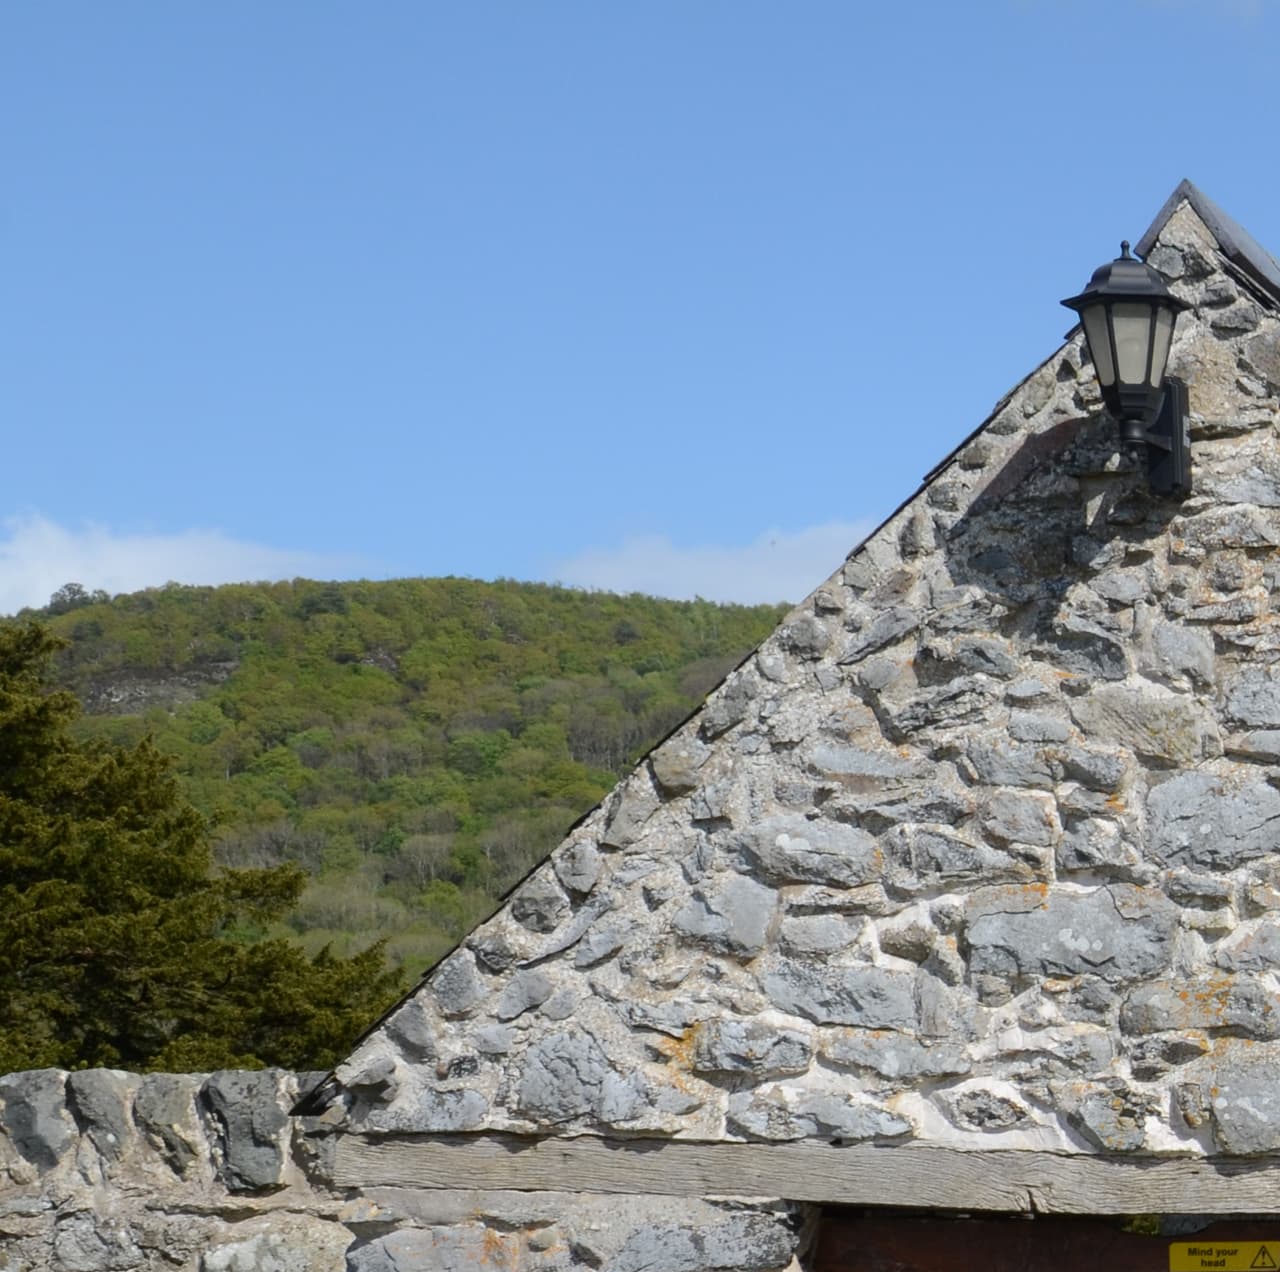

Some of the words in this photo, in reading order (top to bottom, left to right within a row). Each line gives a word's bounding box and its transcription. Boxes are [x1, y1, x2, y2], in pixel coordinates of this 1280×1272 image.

[1188, 1247, 1213, 1256] Mind
[1215, 1248, 1238, 1257] your
[1200, 1258, 1226, 1267] head
